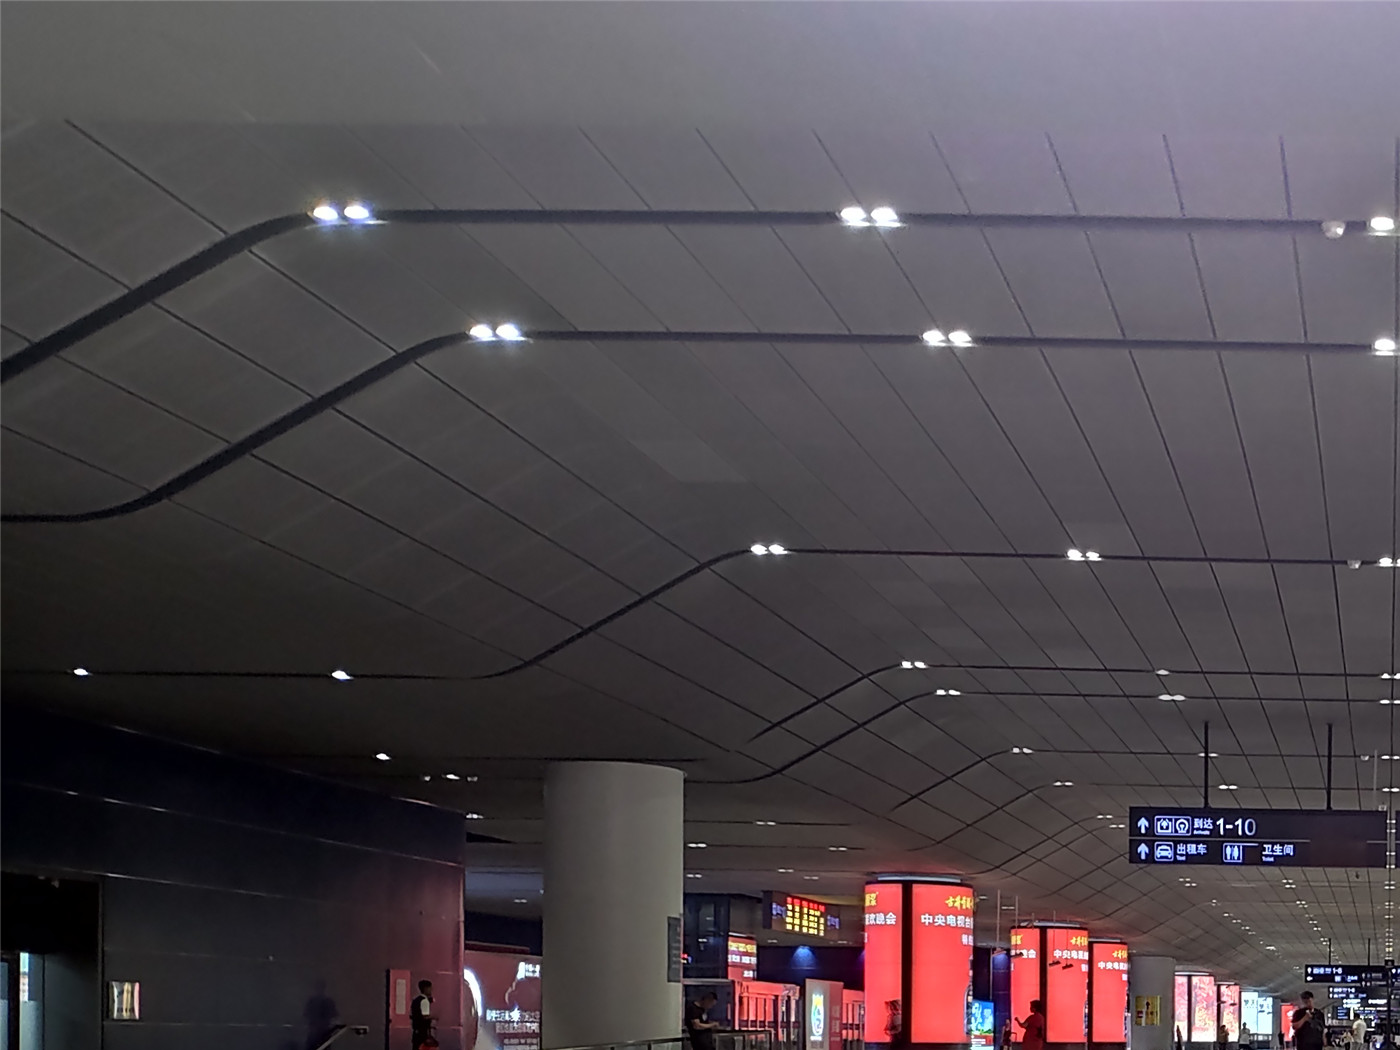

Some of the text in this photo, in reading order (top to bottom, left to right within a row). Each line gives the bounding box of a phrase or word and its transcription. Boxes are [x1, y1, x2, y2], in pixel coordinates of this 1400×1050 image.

[1193, 817, 1256, 836] 到达 1-10
[1176, 843, 1207, 856] 出租车
[1262, 844, 1294, 856] 卫生间
